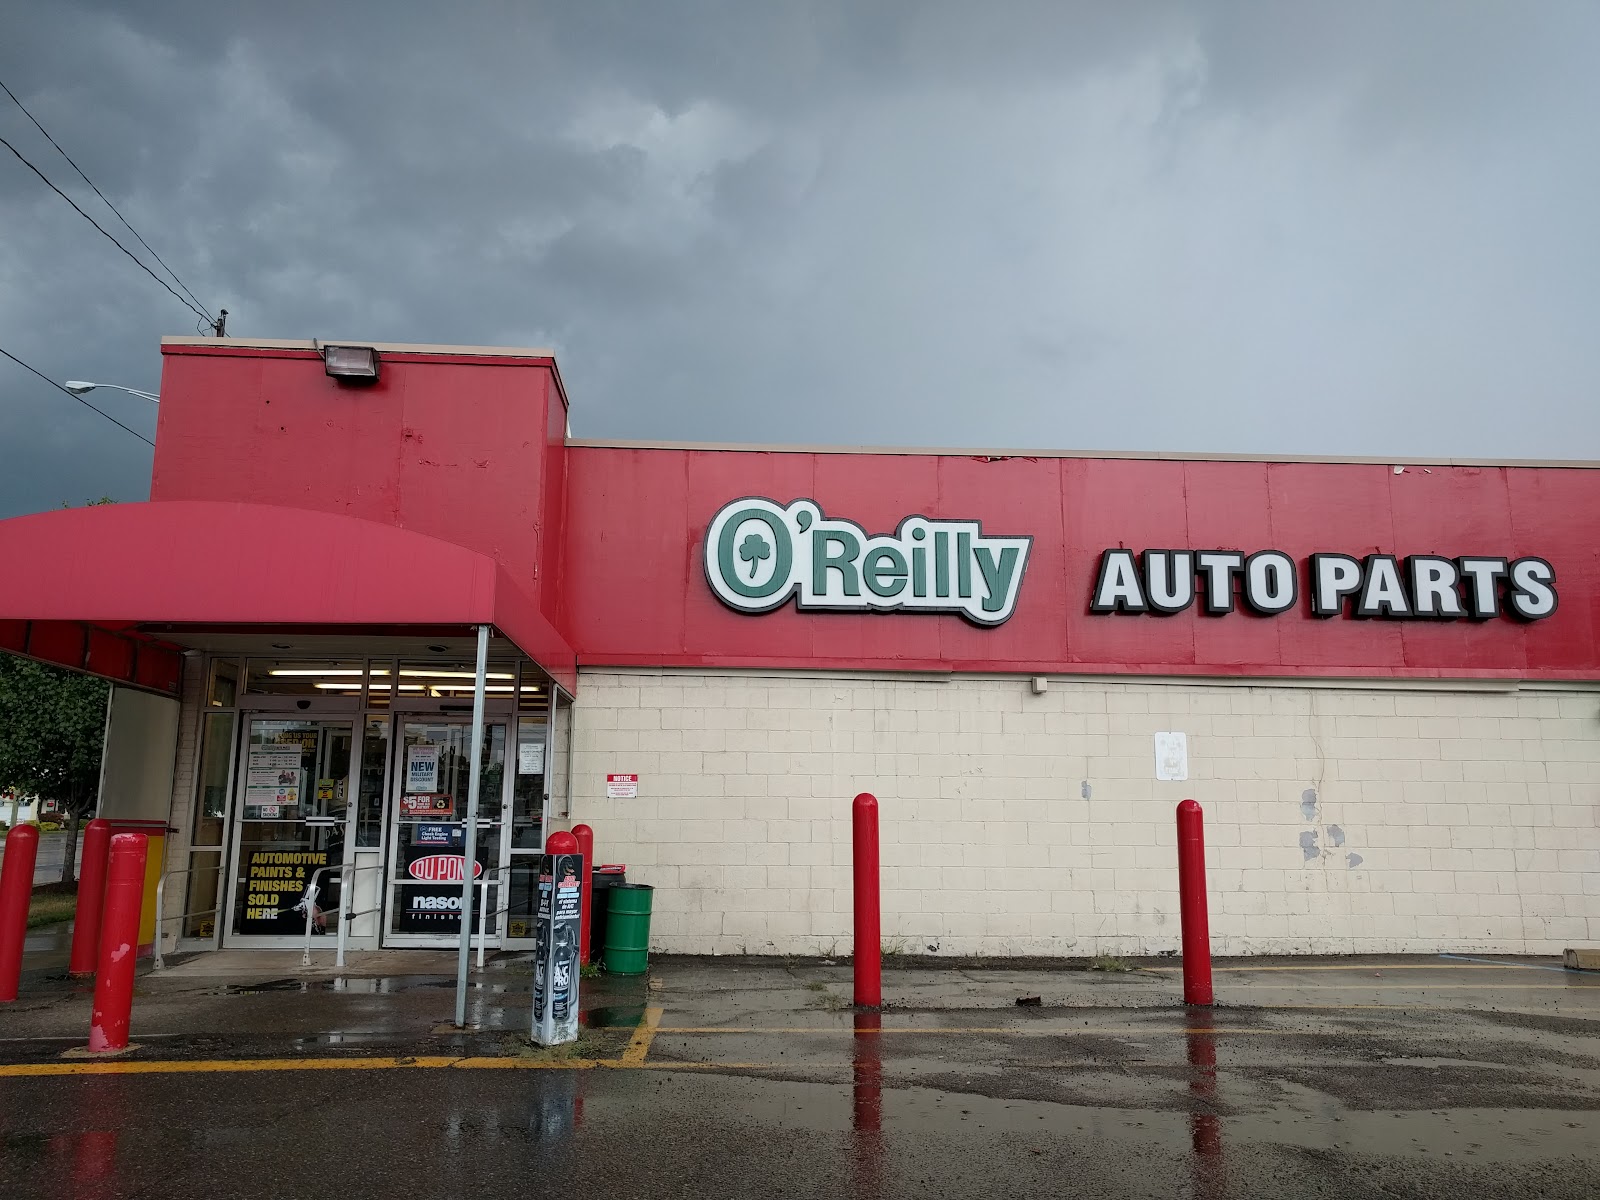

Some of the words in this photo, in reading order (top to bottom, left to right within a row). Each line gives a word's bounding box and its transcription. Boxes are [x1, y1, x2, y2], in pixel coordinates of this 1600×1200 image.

[717, 507, 1020, 612] O'Reilly
[1096, 551, 1296, 610] AUTO
[1317, 556, 1558, 617] PARTS
[410, 761, 435, 772] NEW
[403, 795, 417, 810] $5
[251, 852, 327, 865] AUTOMOTIVE
[250, 866, 293, 878] PAINTS
[295, 866, 306, 878] &
[249, 880, 304, 892] FINISHES
[247, 893, 280, 906] SOLD
[246, 907, 279, 919] HERE
[554, 975, 569, 987] PRO
